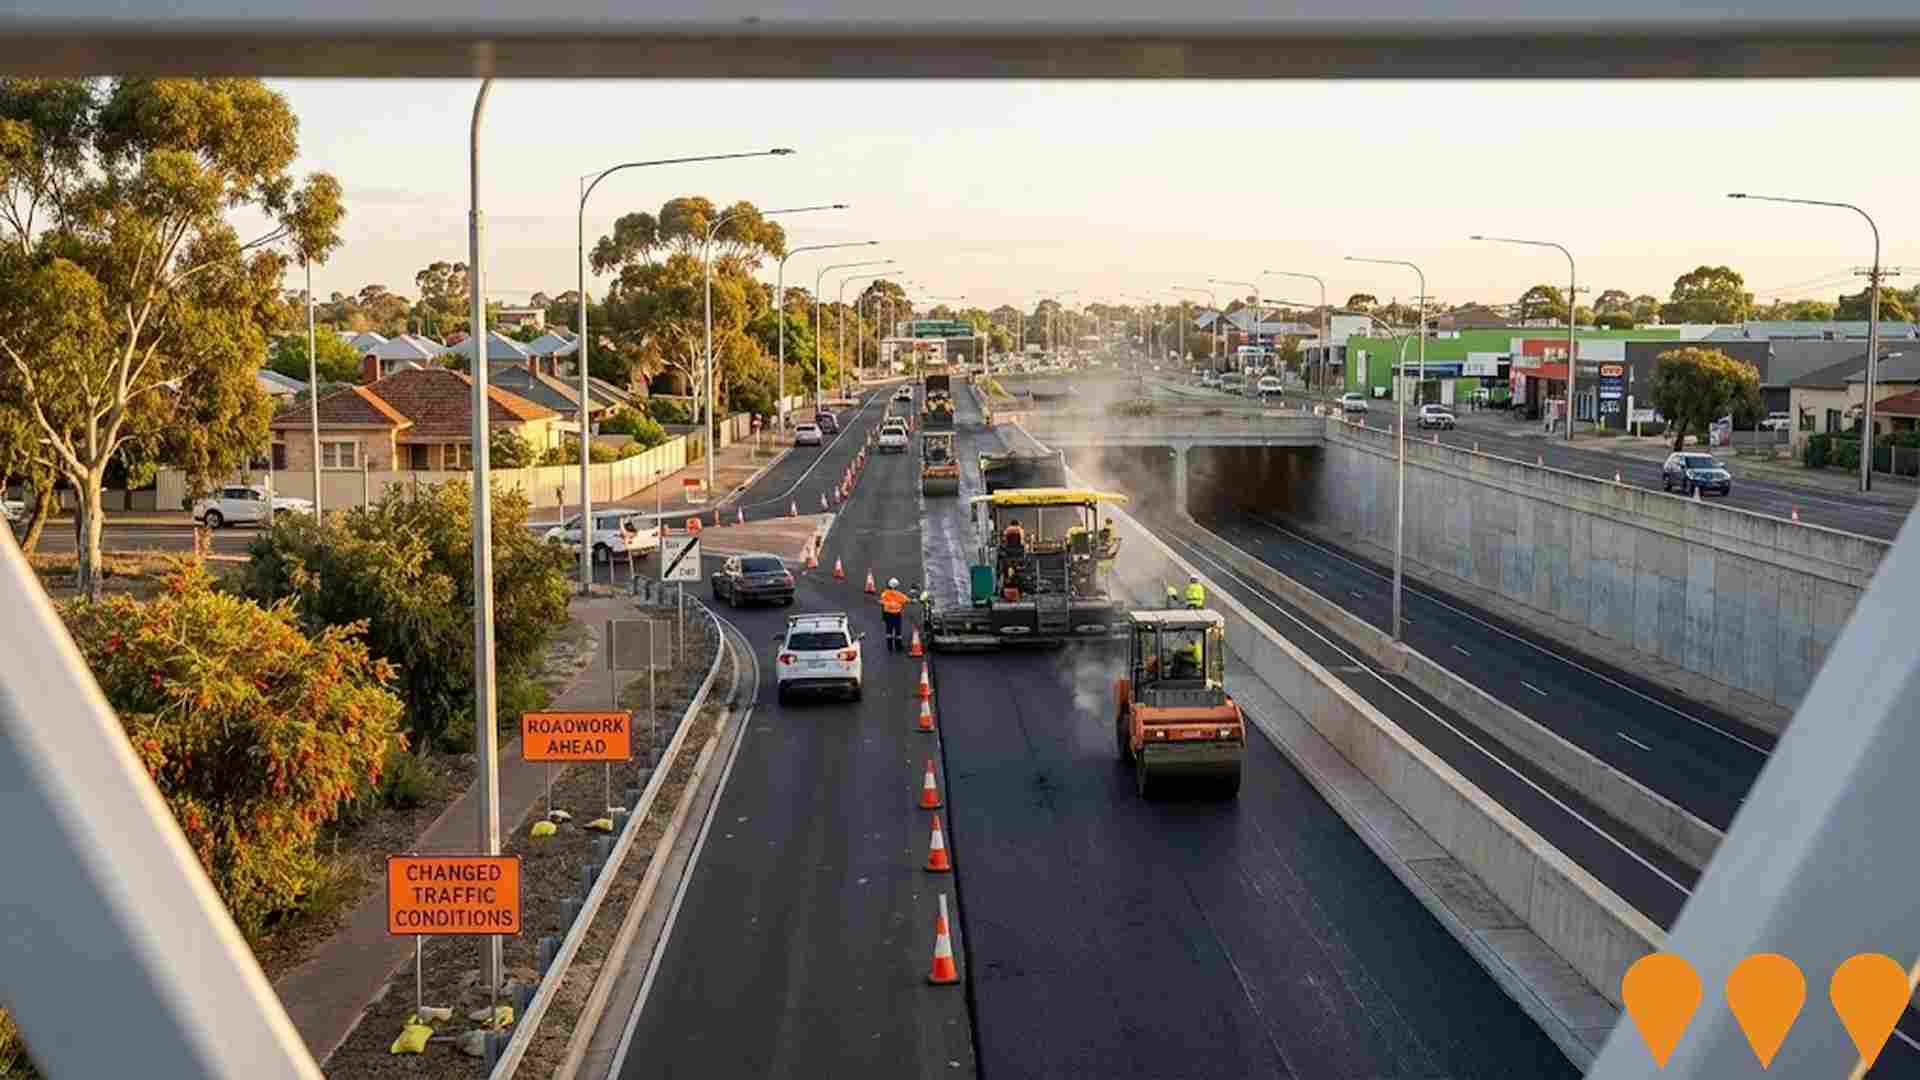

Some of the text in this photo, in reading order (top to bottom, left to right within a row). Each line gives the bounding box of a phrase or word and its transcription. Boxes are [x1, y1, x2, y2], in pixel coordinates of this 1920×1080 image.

[527, 719, 624, 734] ROADWORK
[547, 739, 608, 754] AHEAD
[406, 864, 502, 881] CHANGED
[413, 887, 496, 904] TRAFFIC
[395, 909, 513, 927] CONDITIONS
